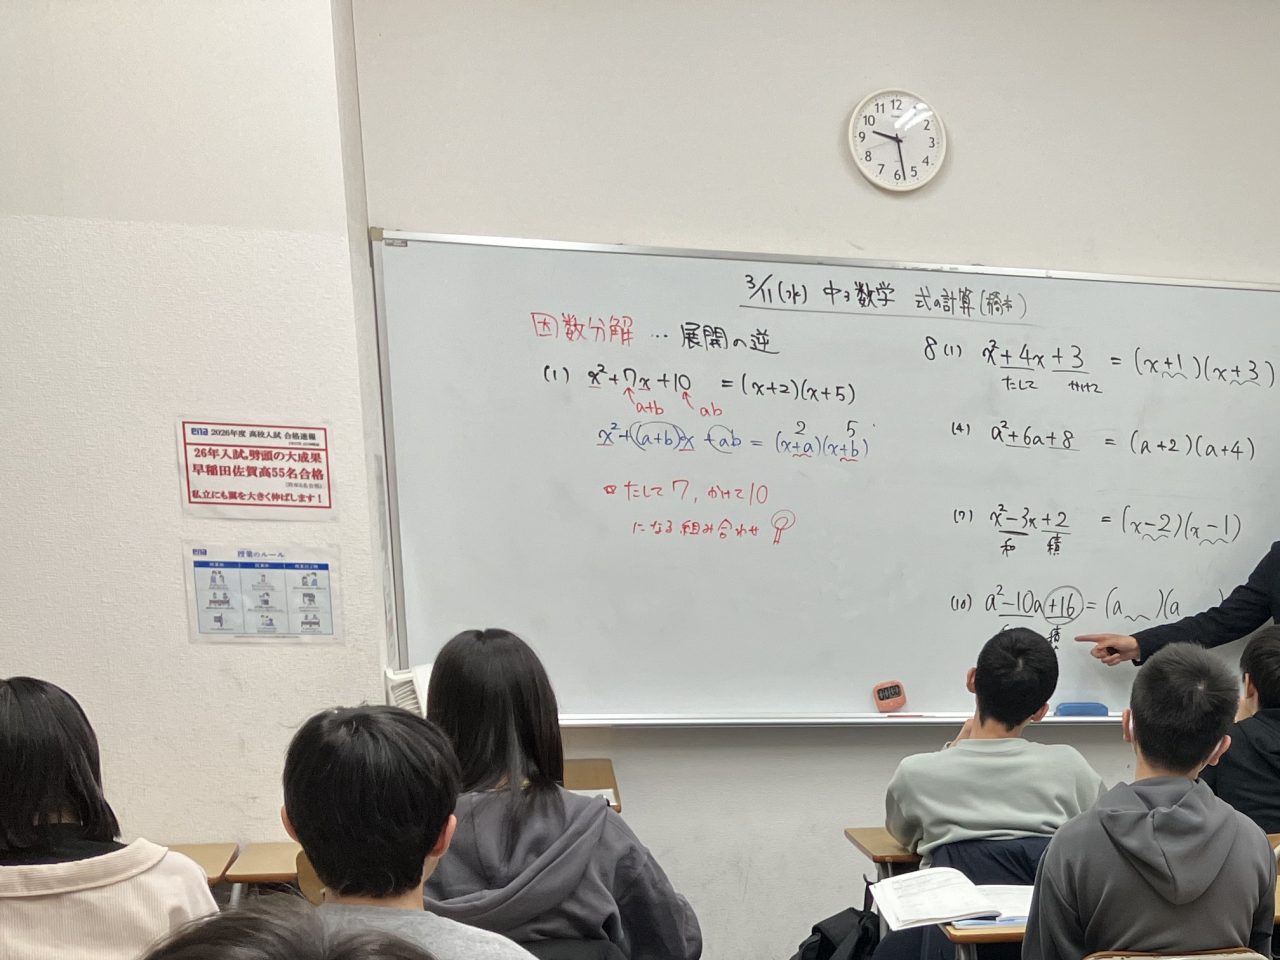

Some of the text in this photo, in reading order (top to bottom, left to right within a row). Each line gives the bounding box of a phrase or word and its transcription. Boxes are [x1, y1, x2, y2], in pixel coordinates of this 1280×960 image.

[875, 103, 885, 113] 11
[891, 99, 902, 110] 12
[863, 115, 875, 126] 10
[923, 119, 930, 130] 2
[858, 132, 865, 142] 9
[928, 137, 935, 148] 3
[864, 151, 872, 162] 8
[922, 156, 929, 166] 4
[878, 164, 885, 175] 7
[894, 170, 901, 180] 6
[911, 166, 917, 177] 5
[531, 312, 634, 346] 因数分解
[681, 322, 780, 354] 展開の逆
[543, 365, 570, 384] (1)
[700, 403, 723, 417] ab
[191, 427, 208, 436] ena
[795, 421, 806, 435] 2
[846, 420, 859, 438] 5
[951, 422, 970, 436] (4)
